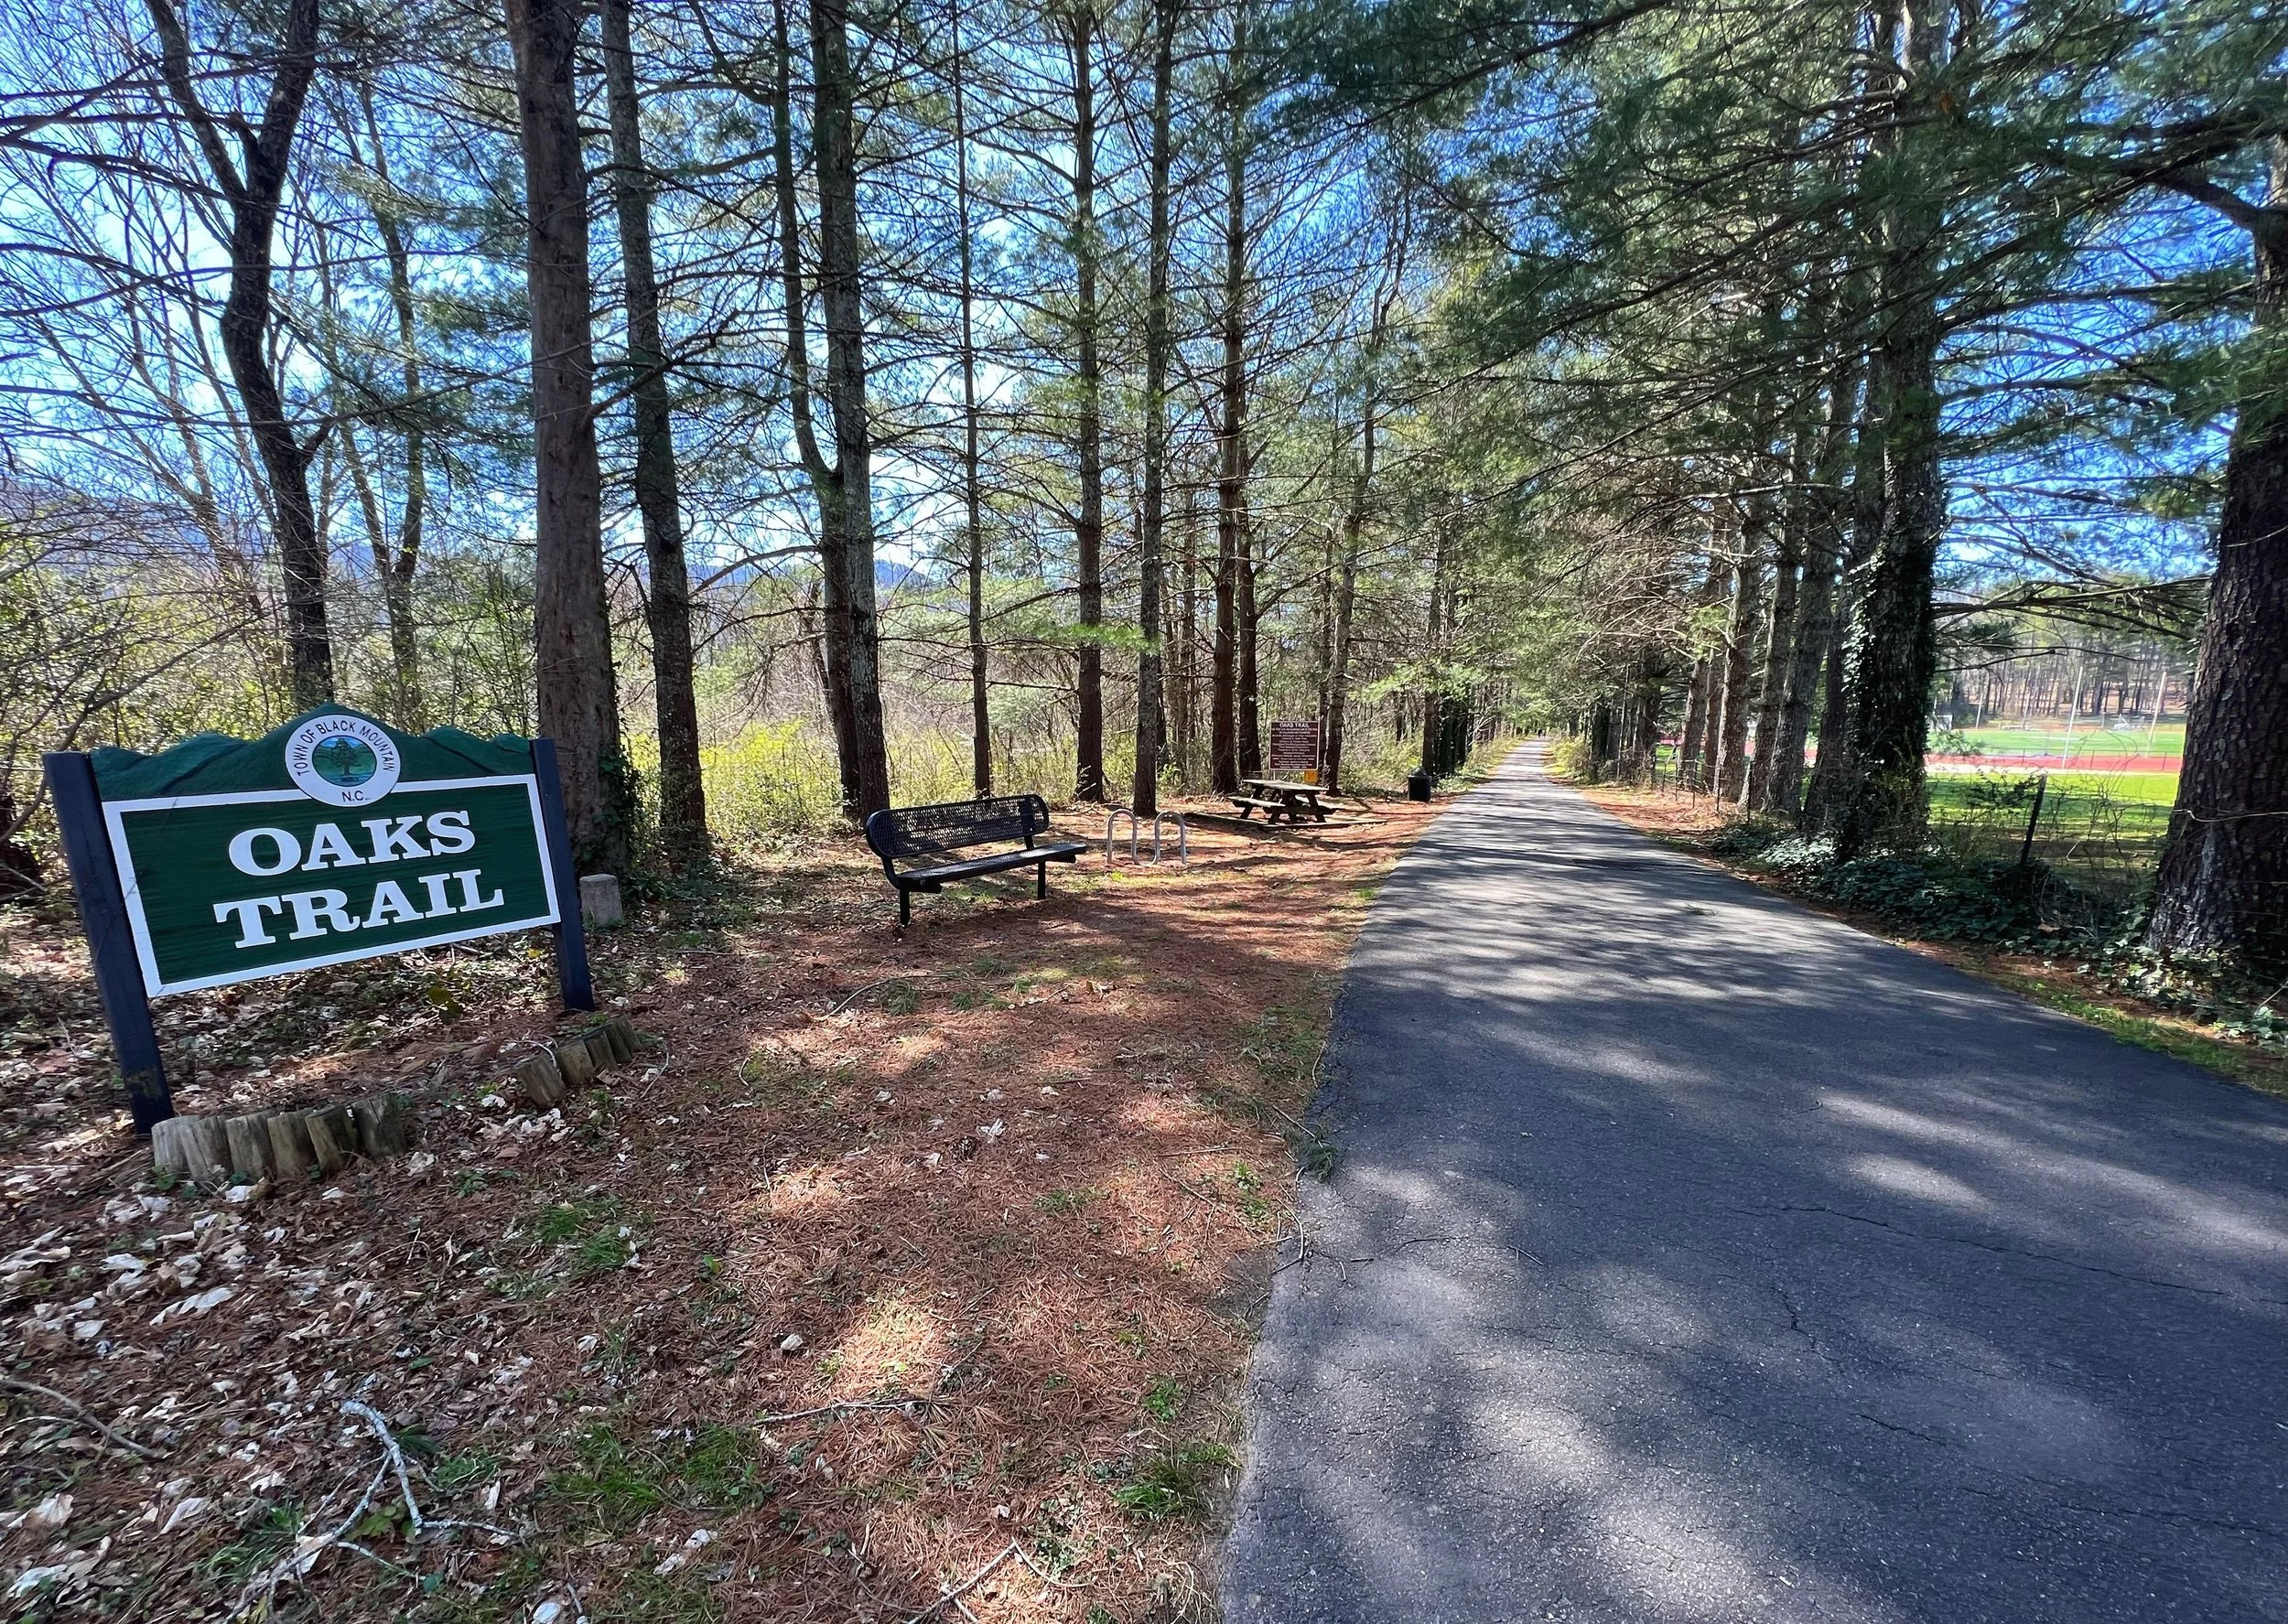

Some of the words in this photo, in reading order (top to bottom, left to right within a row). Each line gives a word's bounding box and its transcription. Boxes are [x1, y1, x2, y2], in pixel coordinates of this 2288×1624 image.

[300, 729, 316, 744] OF
[316, 720, 356, 734] BLACK
[294, 744, 310, 776] TOWN
[360, 726, 395, 772] MOUNTAIN
[228, 810, 476, 877] OAKS
[213, 868, 504, 950] TRAIL
